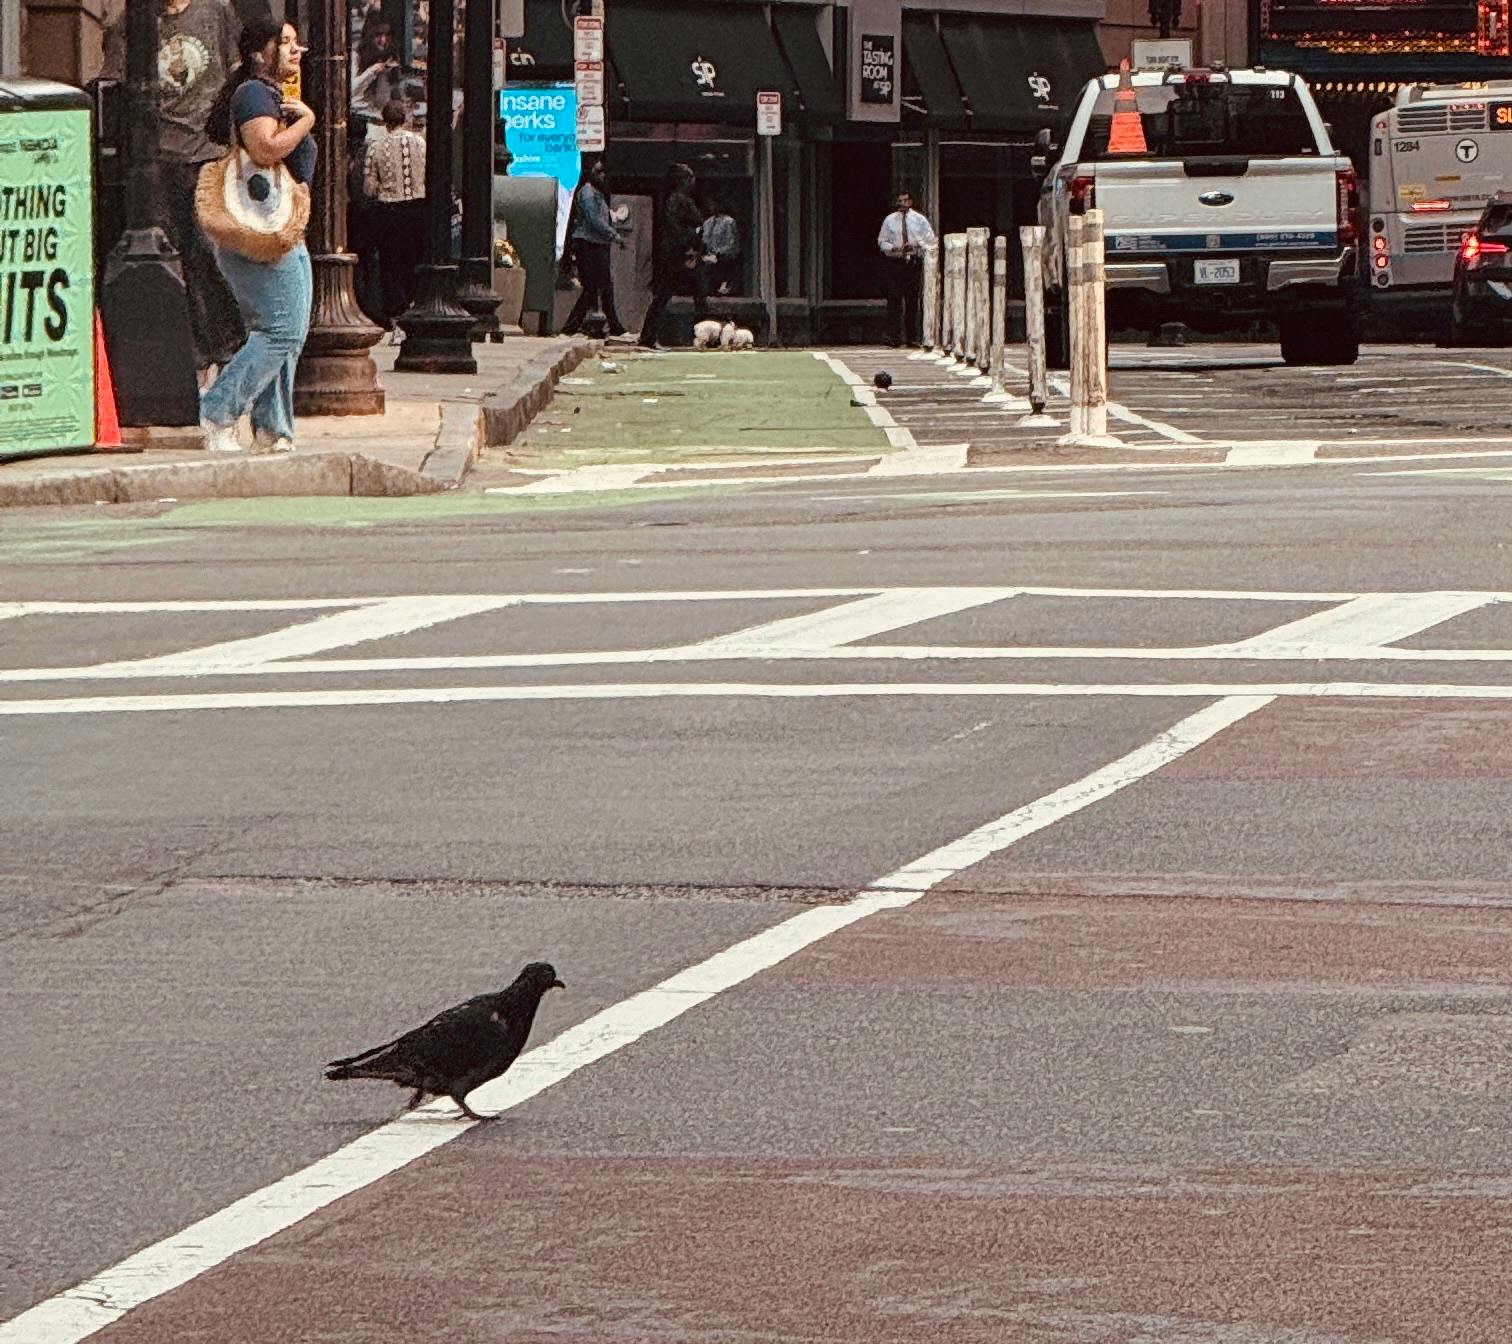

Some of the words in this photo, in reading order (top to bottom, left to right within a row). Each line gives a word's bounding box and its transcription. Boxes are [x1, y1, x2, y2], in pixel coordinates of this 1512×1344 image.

[863, 50, 894, 66] TASTING
[862, 64, 888, 80] ROOM
[1393, 140, 1420, 153] 1284
[23, 226, 58, 263] BIG
